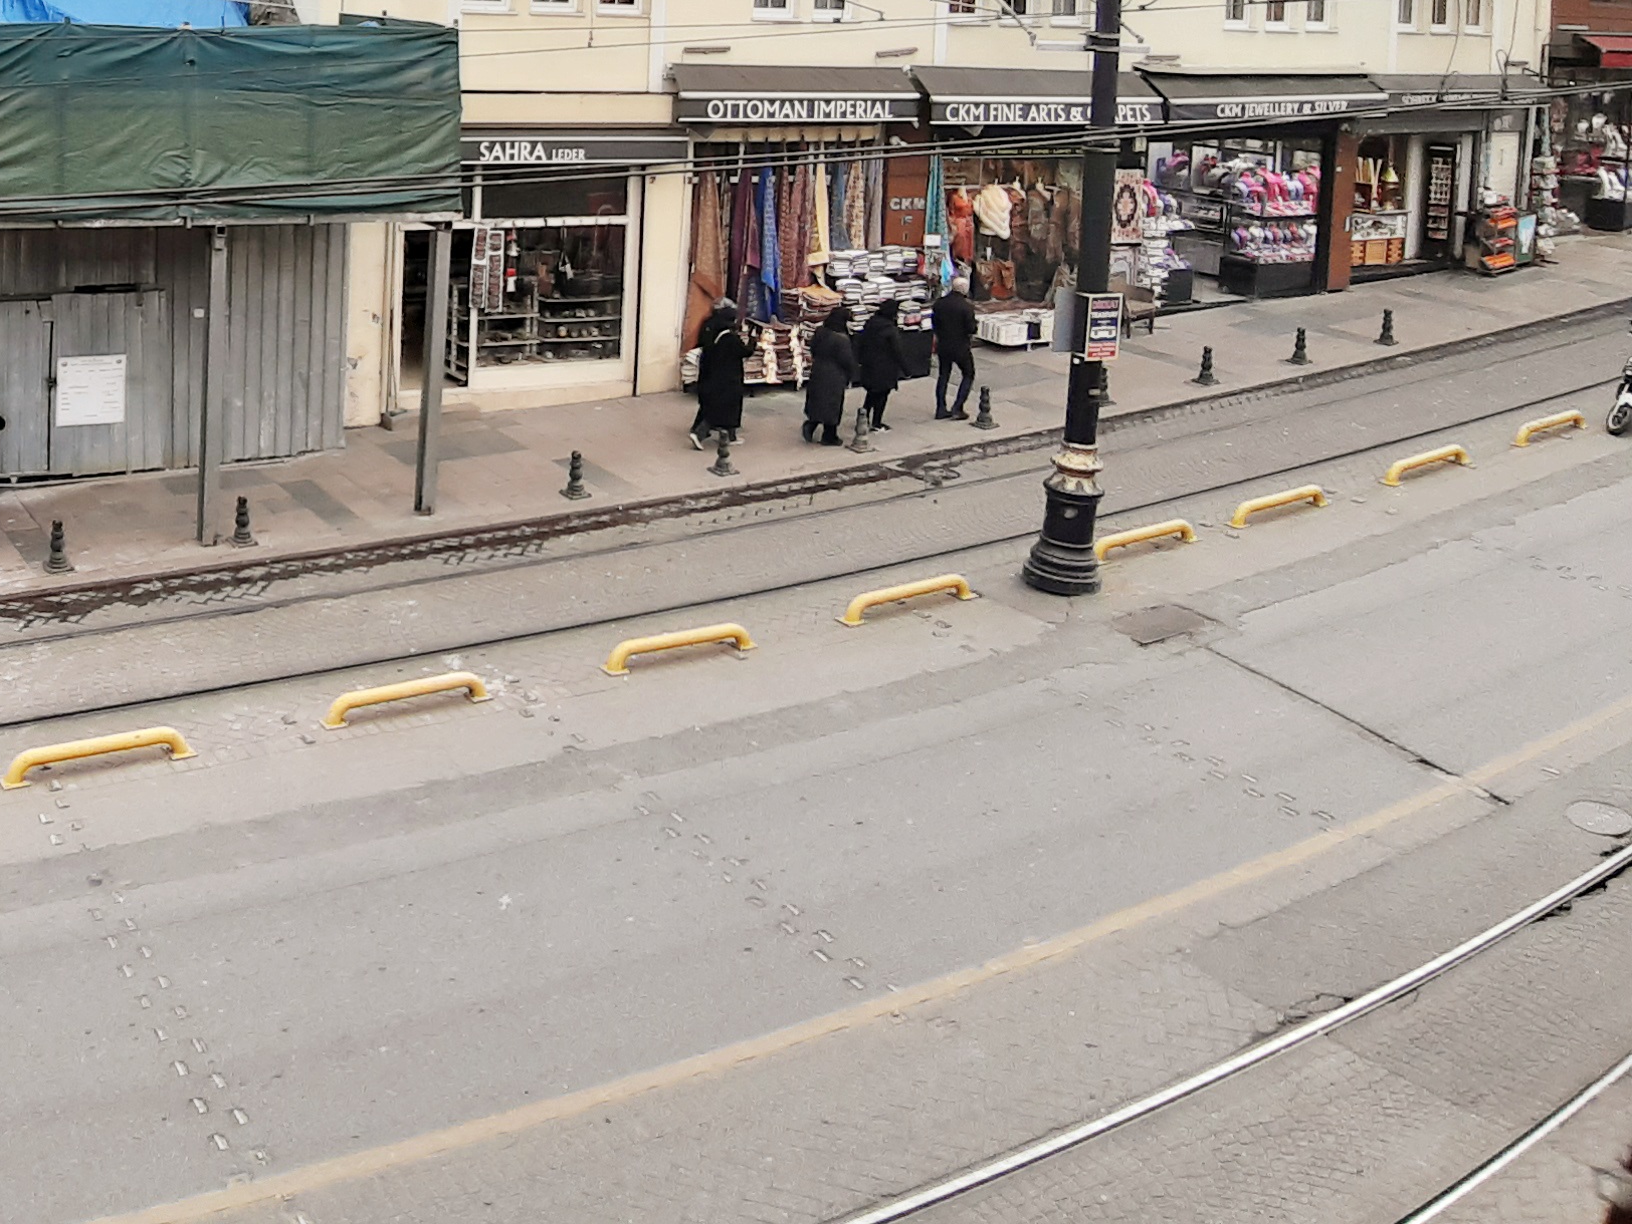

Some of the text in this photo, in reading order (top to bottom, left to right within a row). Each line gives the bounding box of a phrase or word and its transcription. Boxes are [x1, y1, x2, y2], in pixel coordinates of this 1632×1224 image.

[706, 100, 894, 119] OTTOMAN IMPERIAL
[945, 103, 985, 122] CKM
[989, 104, 1024, 122] FINE
[1026, 104, 1066, 122] ARTS
[1069, 106, 1084, 122] &
[1215, 100, 1349, 119] CKM JEWELLERY & SILVER
[479, 141, 586, 161] SAHRA LEDER
[889, 197, 926, 210] CKM
